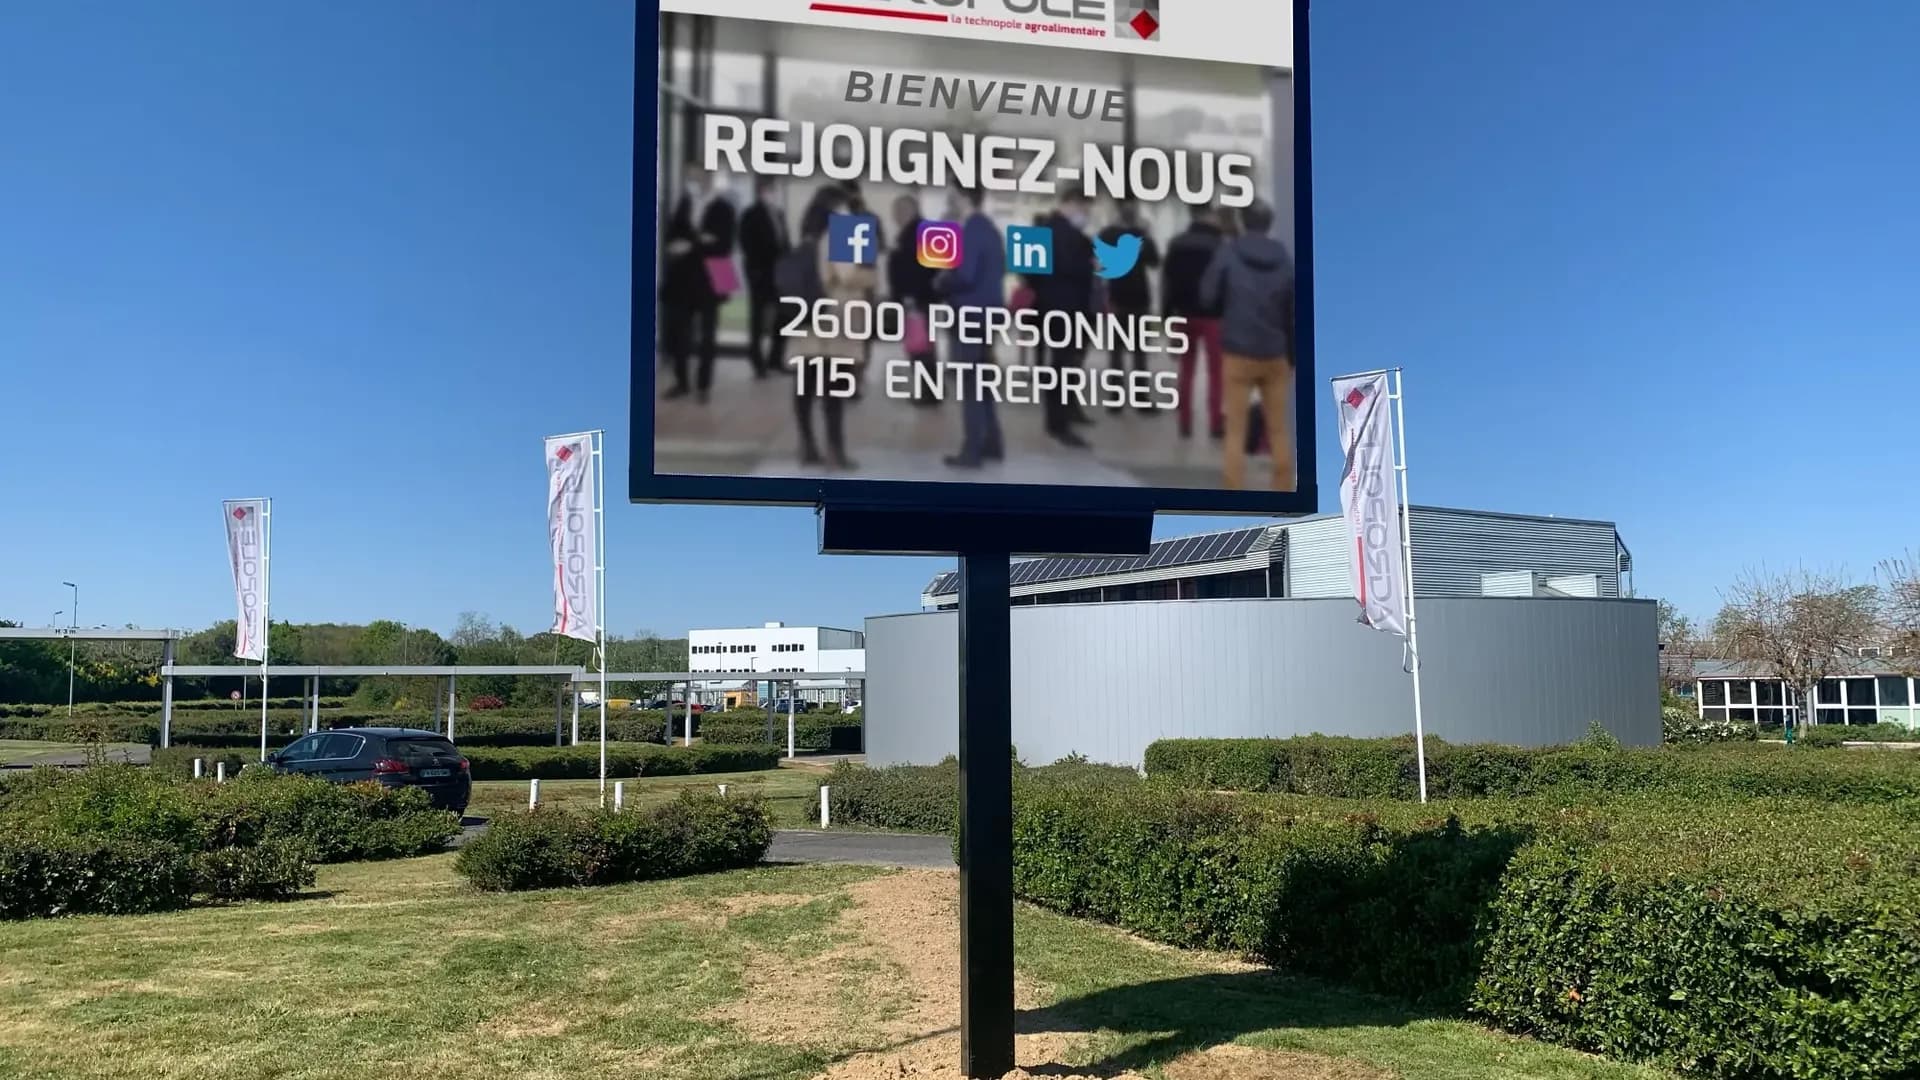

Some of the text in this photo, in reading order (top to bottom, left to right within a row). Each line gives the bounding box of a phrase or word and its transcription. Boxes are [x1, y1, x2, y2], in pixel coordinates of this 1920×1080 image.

[951, 14, 1106, 37] la technopole agroalimentaire
[845, 70, 1127, 121] BIENVENUE
[703, 113, 1255, 208] REJOIGNEZ-NOUS
[779, 296, 1190, 355] 2600 PERSONNES
[788, 355, 1180, 410] 115 ENTREPRISES
